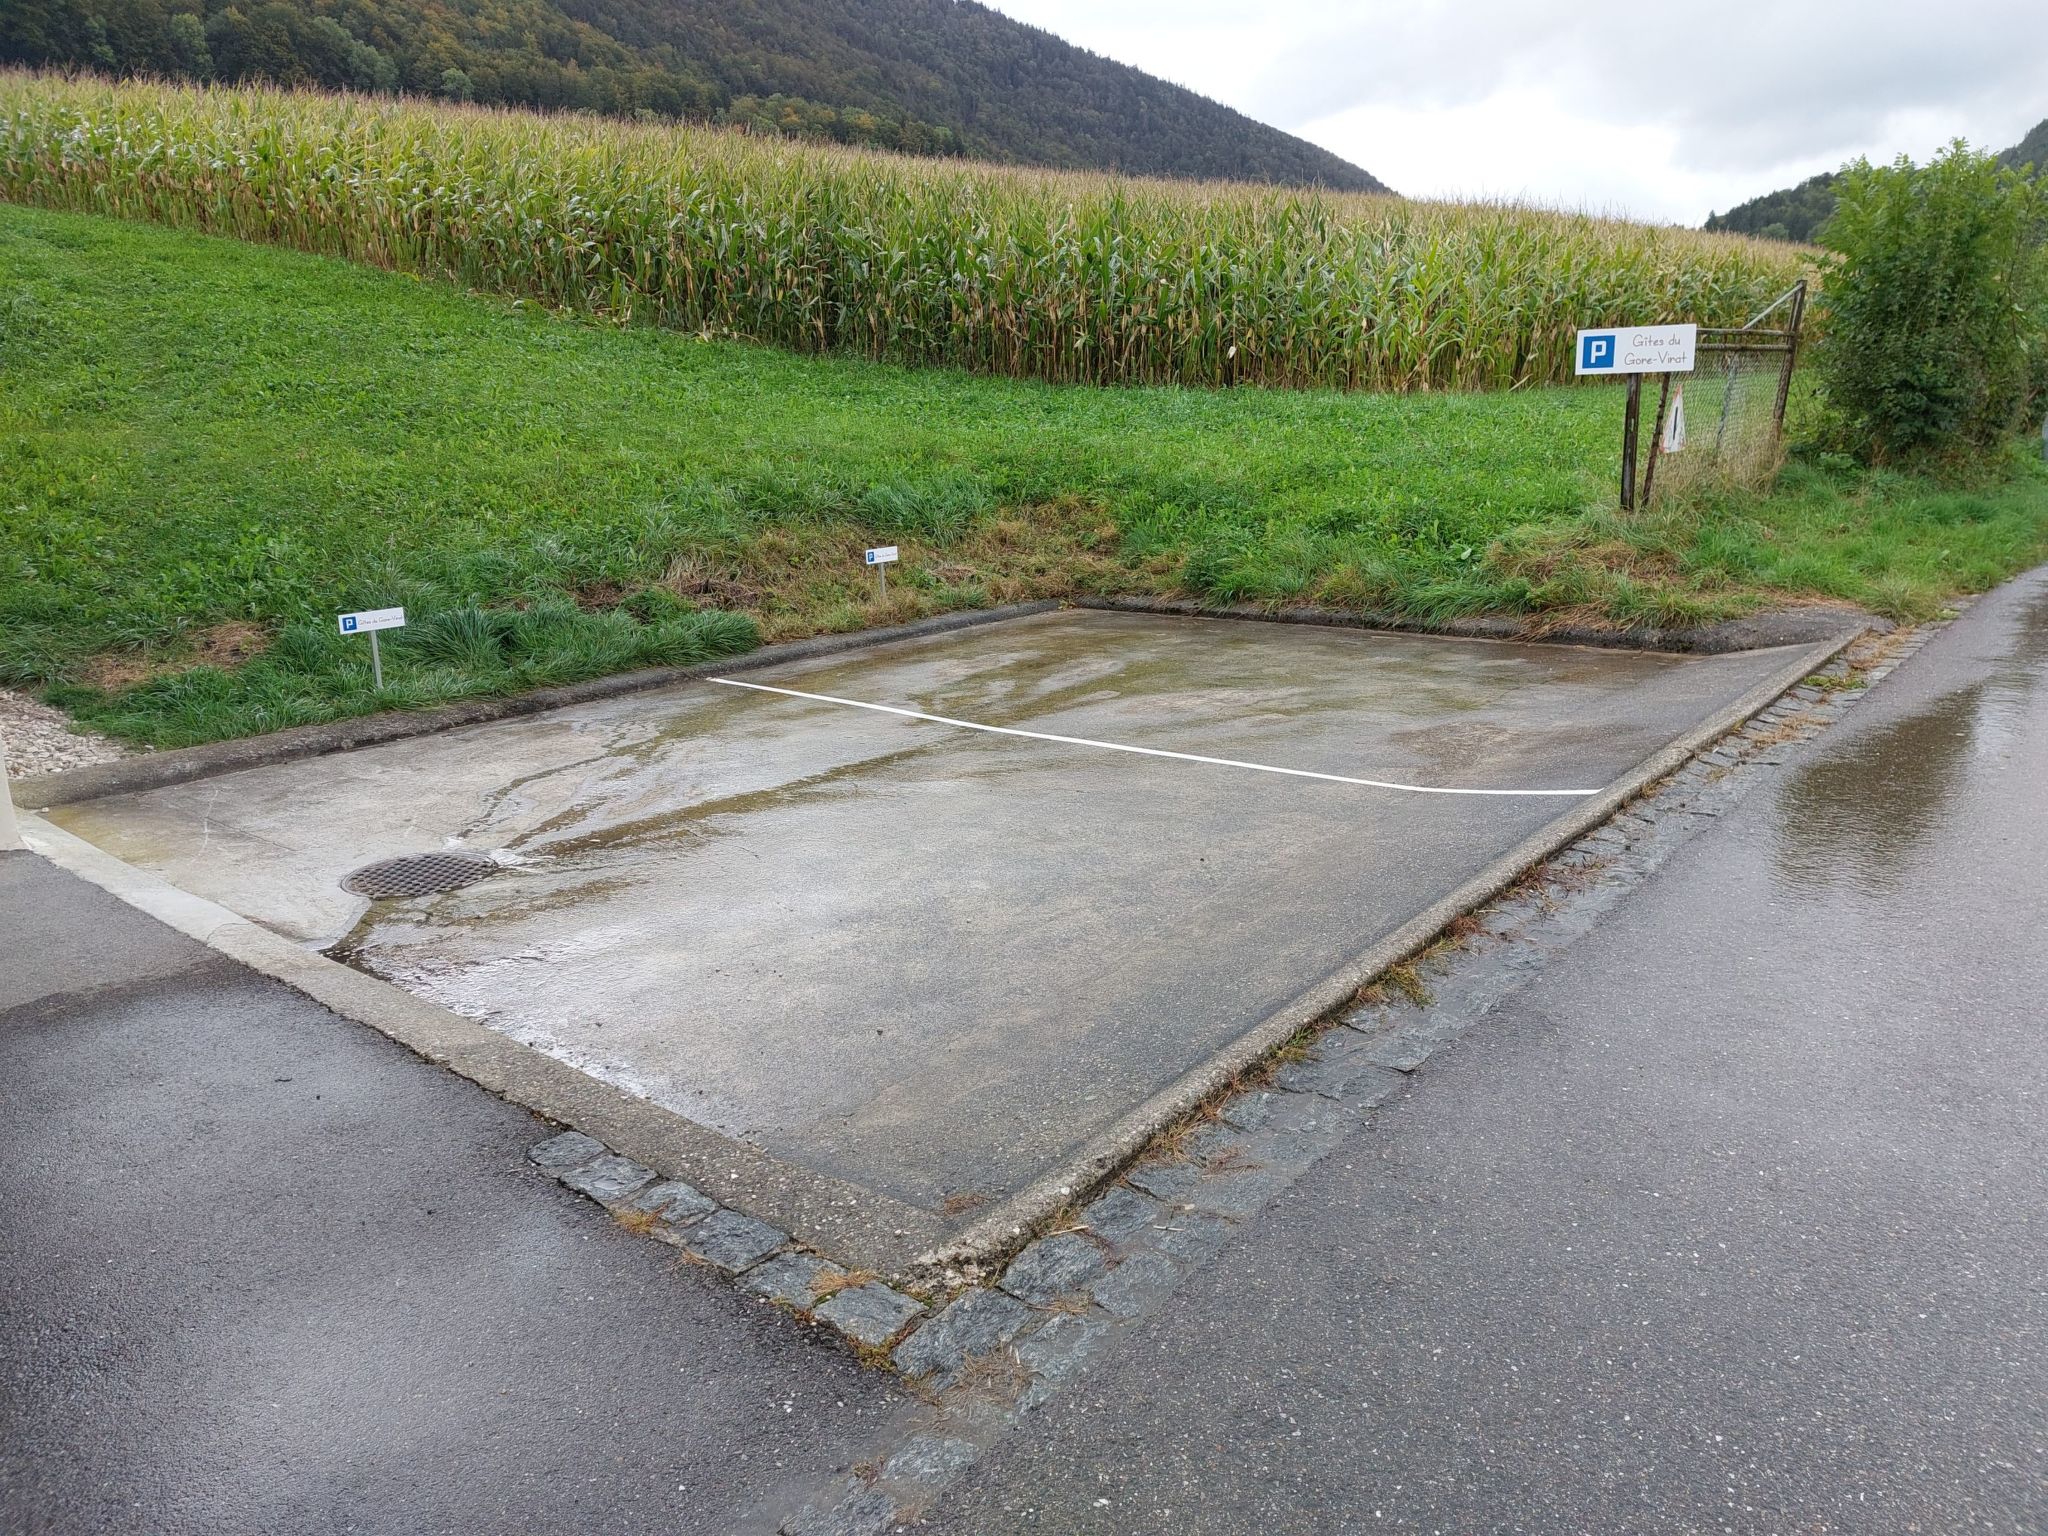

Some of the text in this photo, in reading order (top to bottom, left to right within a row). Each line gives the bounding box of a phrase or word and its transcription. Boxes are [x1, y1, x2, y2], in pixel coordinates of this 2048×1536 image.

[1668, 333, 1681, 346] du
[1590, 341, 1607, 364] P
[1624, 351, 1687, 366] Gore-Virat
[346, 619, 353, 629] P
